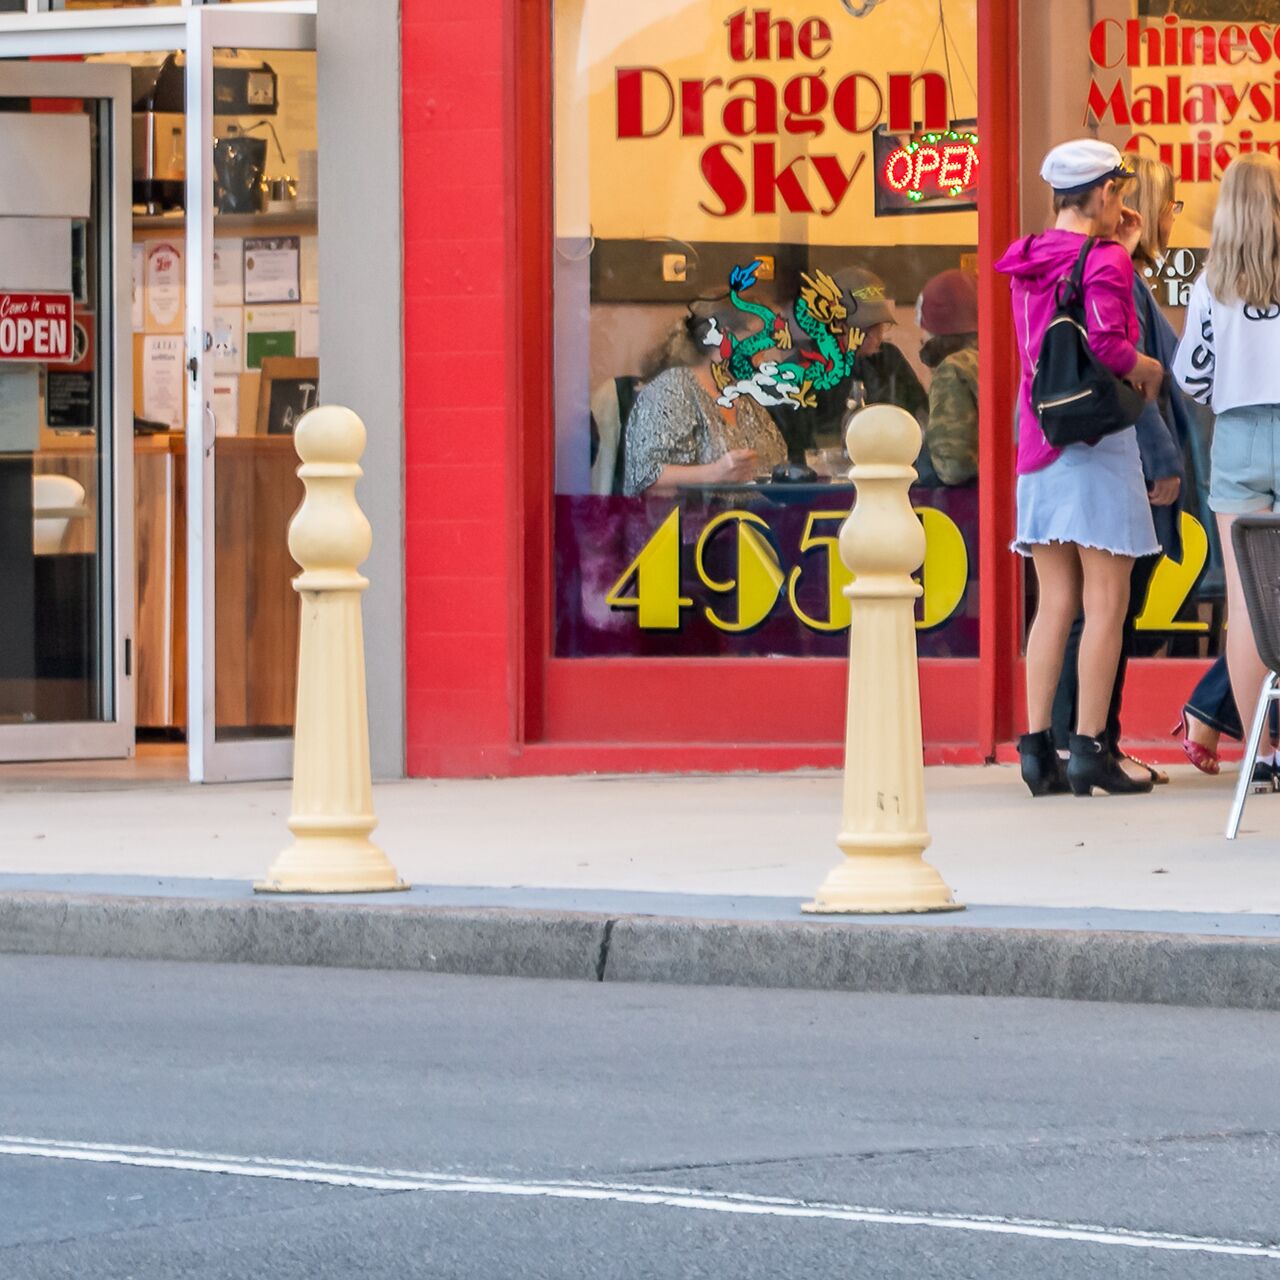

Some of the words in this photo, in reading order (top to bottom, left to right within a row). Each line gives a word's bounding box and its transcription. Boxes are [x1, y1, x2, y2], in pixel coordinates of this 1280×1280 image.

[724, 6, 832, 62] the
[615, 66, 950, 139] Dragon
[698, 141, 866, 218] Sky
[0, 295, 29, 318] Come
[31, 296, 41, 312] in
[0, 318, 67, 354] OPEN
